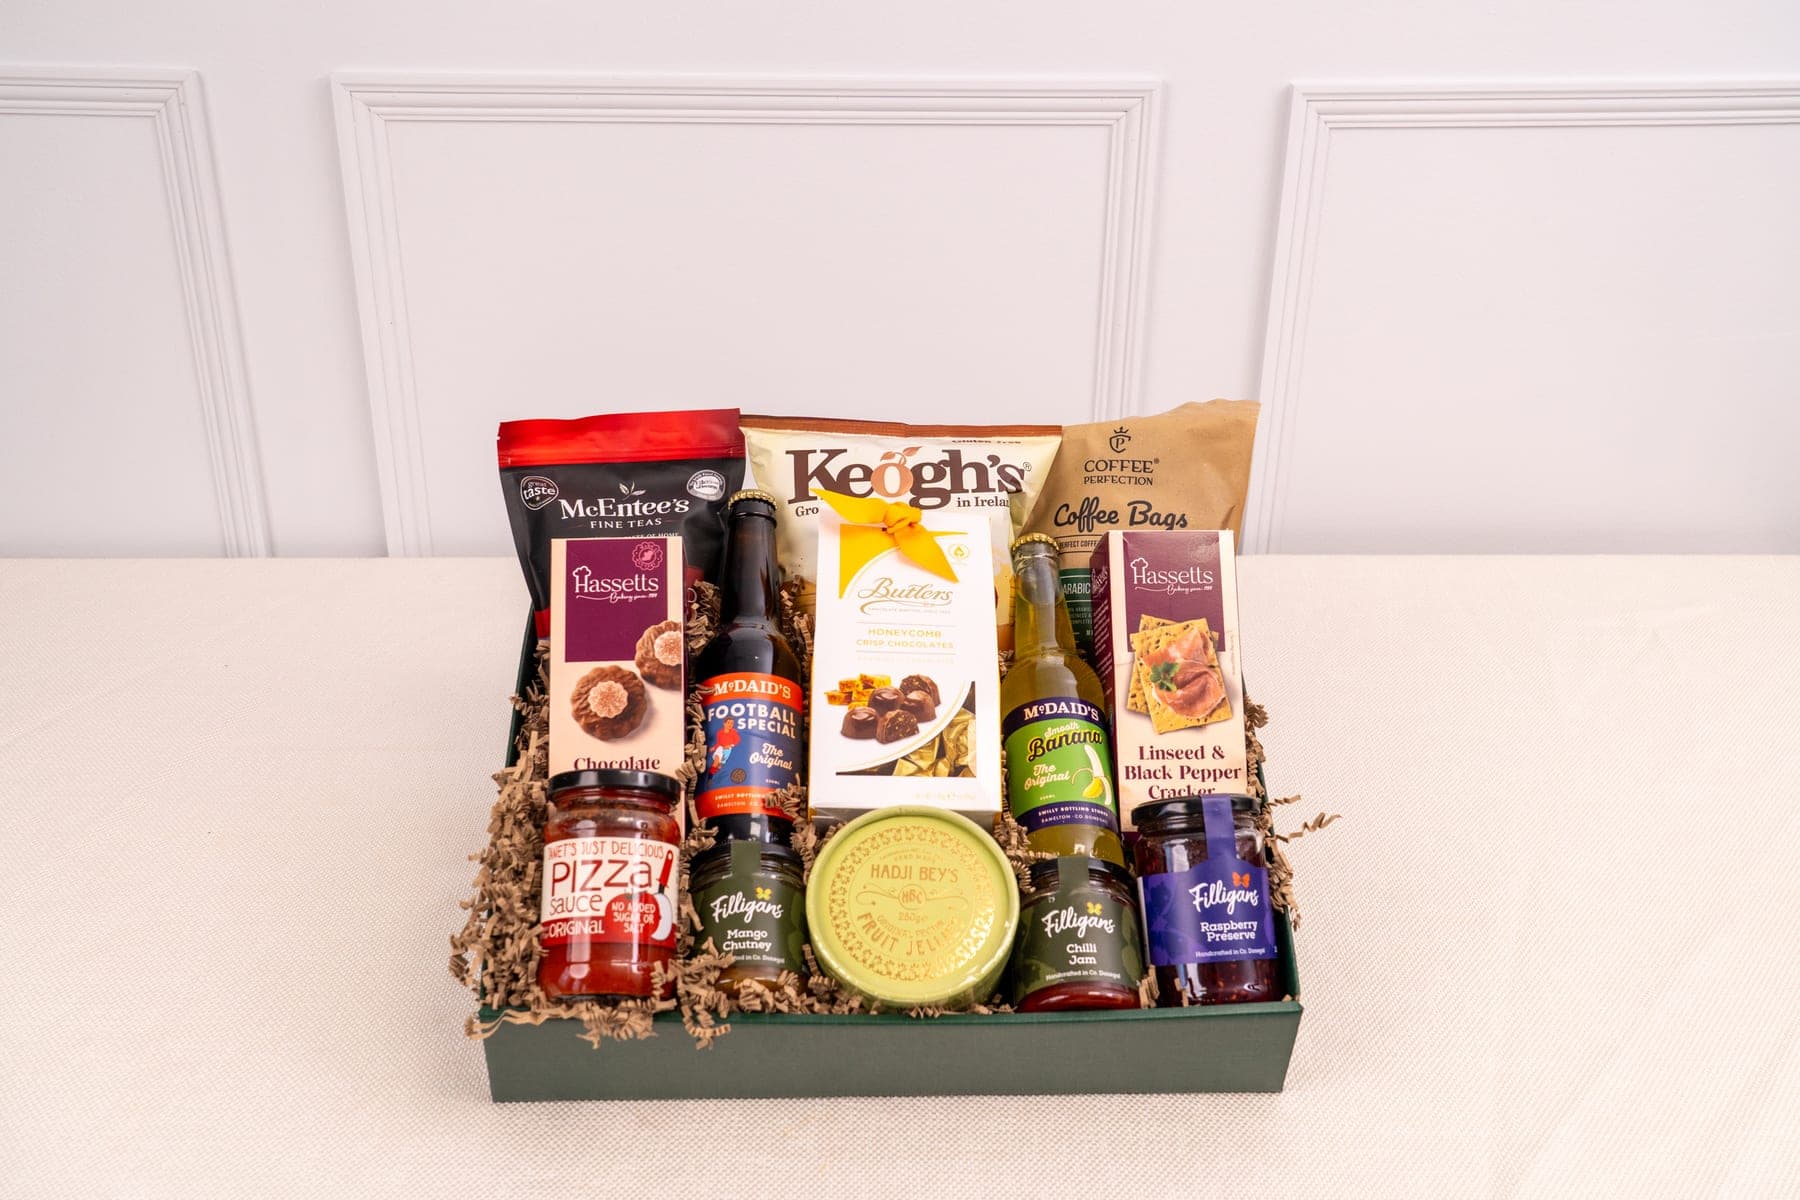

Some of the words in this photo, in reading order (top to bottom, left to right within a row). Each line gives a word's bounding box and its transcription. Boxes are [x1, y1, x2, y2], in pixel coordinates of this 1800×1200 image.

[1084, 459, 1153, 473] COFFEE
[1083, 475, 1153, 486] PERFECTION
[523, 486, 556, 500] taste
[558, 498, 689, 519] McEntee's
[795, 505, 819, 518] Gro
[957, 497, 971, 508] in
[1054, 496, 1119, 533] Coffee
[1127, 500, 1188, 531] Bags
[590, 520, 623, 529] FINE
[629, 518, 662, 528] TEAS
[1131, 557, 1213, 584] Hassetts
[573, 566, 659, 592] Hassetts
[857, 577, 954, 602] Butlers
[1063, 582, 1091, 594] ARABIC
[868, 628, 942, 638] HONEYCOMB
[856, 639, 885, 647] CRISP
[887, 640, 954, 649] CHOCOLATES
[708, 703, 796, 726] FOOTBALL
[737, 718, 796, 739] SPECIAL
[1044, 721, 1081, 738] Smooth
[762, 743, 784, 757] The
[1027, 729, 1104, 762] Banana
[1138, 745, 1205, 760] Linseed
[1212, 745, 1225, 760] &
[573, 756, 661, 770] Chocolate
[749, 751, 793, 770] Original
[1033, 763, 1056, 776] The
[1124, 765, 1173, 780] Black
[1180, 765, 1241, 782] Pepper
[1024, 771, 1071, 791] Original
[1148, 784, 1216, 799] Cracker
[581, 841, 607, 856] JUST
[611, 840, 665, 859] DELCIOUS
[871, 864, 913, 880] HADJI
[919, 866, 959, 883] BEY'S
[549, 893, 603, 916] sauce
[1188, 879, 1259, 915] Filligans
[611, 902, 625, 911] NO
[627, 903, 656, 914] ADED
[710, 891, 784, 923] Filligans
[613, 911, 640, 923] SUG
[643, 914, 654, 924] OR
[1041, 906, 1115, 938] Filligans
[623, 923, 644, 934] SAT
[857, 912, 900, 952] FRUIT
[1200, 920, 1258, 933] Raspberry
[727, 928, 768, 941] Mango
[1206, 931, 1256, 942] Preserve
[722, 940, 772, 952] Chutney
[1066, 943, 1097, 953] Chilli
[1068, 955, 1097, 965] Jam
